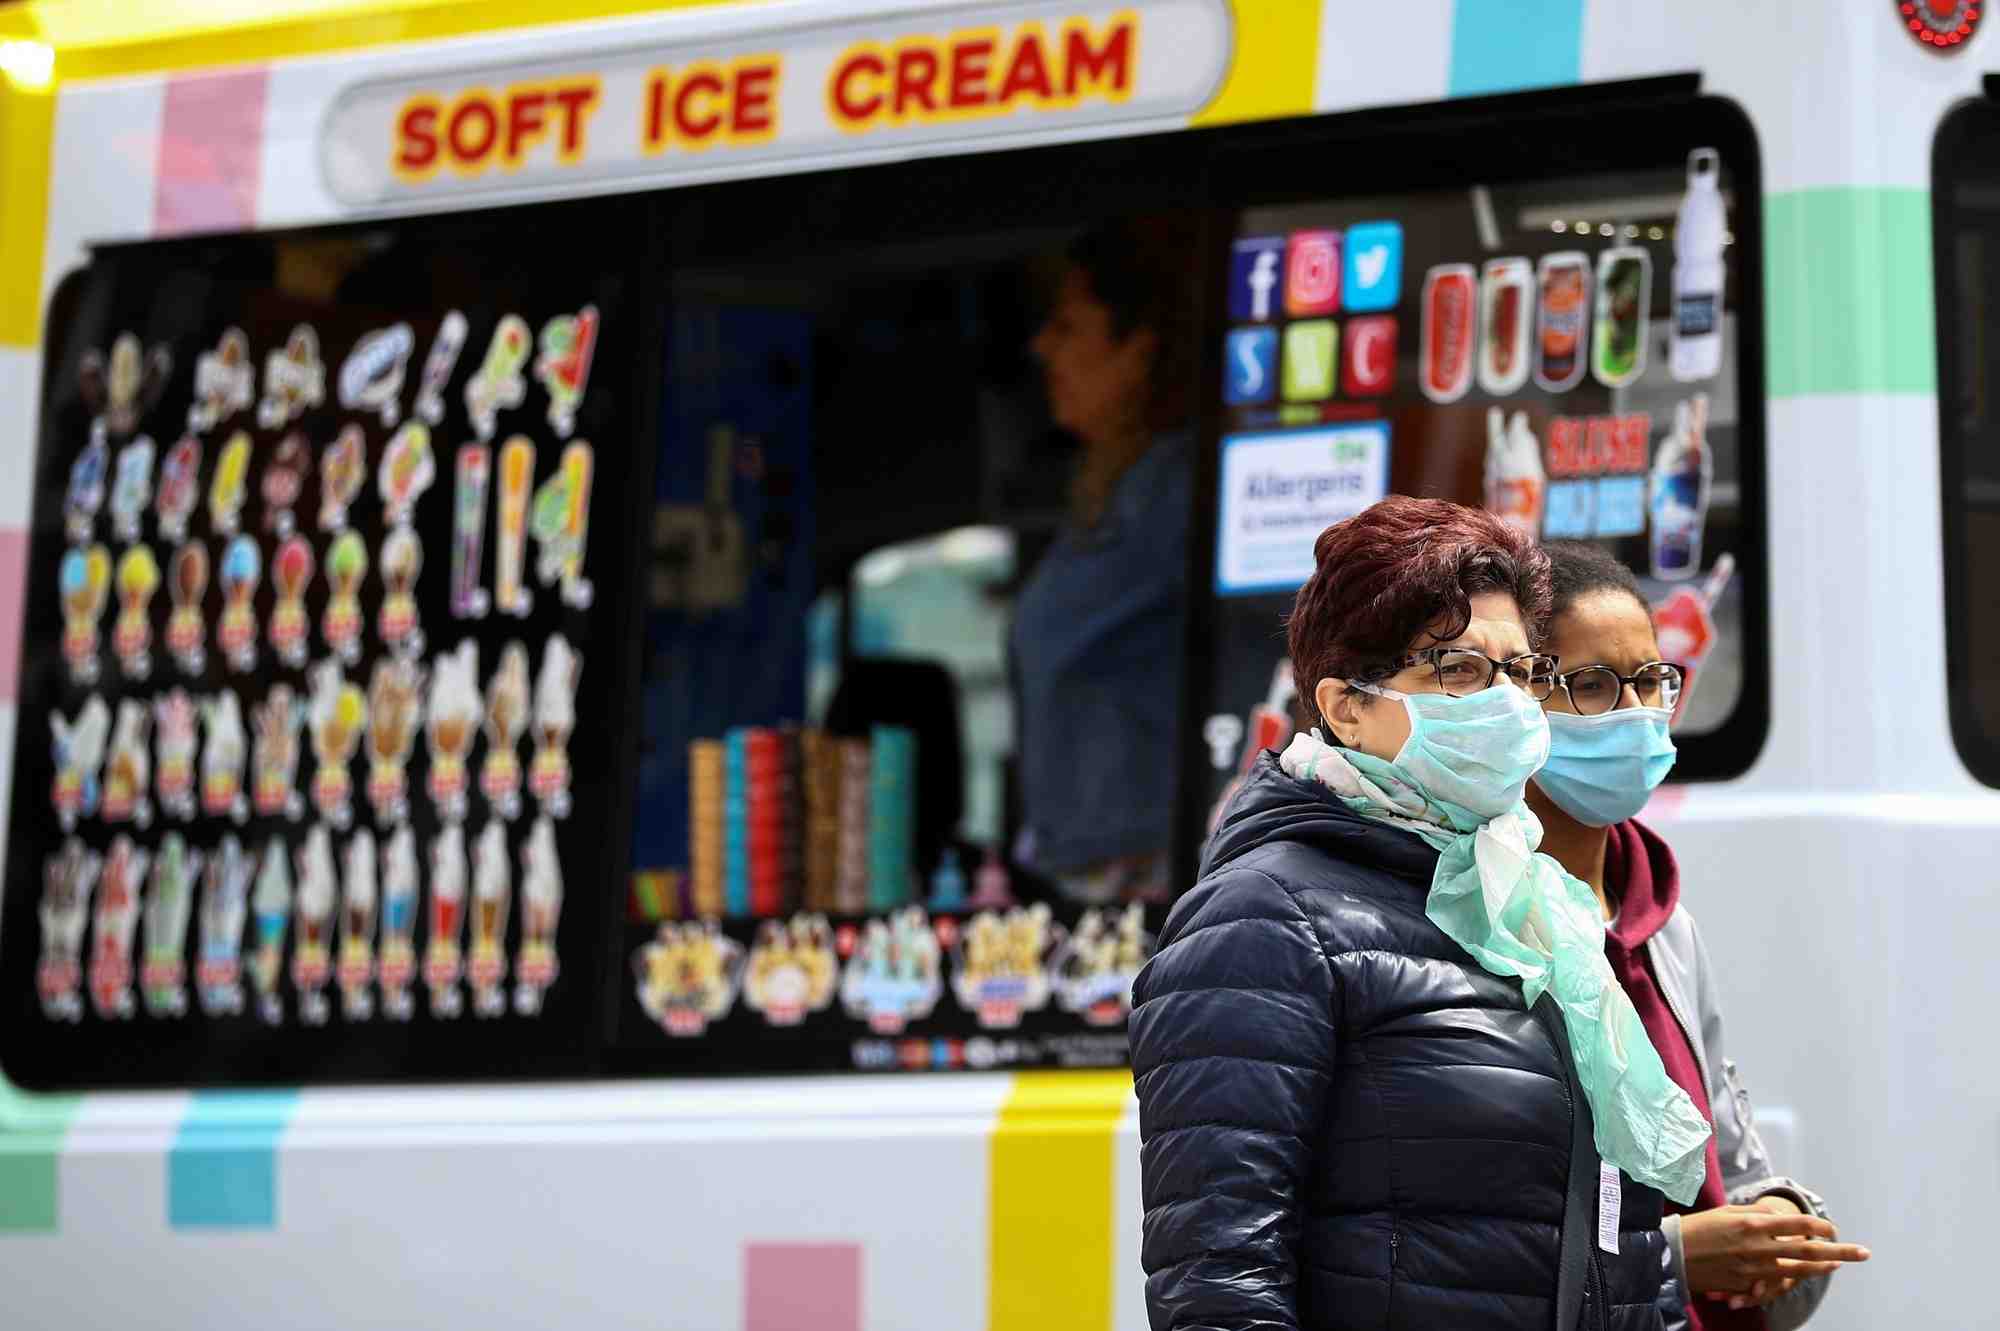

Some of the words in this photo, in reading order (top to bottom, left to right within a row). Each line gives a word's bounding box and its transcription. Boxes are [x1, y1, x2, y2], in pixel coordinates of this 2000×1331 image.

[395, 82, 600, 173] SOFT
[643, 60, 780, 149] ICE
[828, 19, 1135, 127] CREAM
